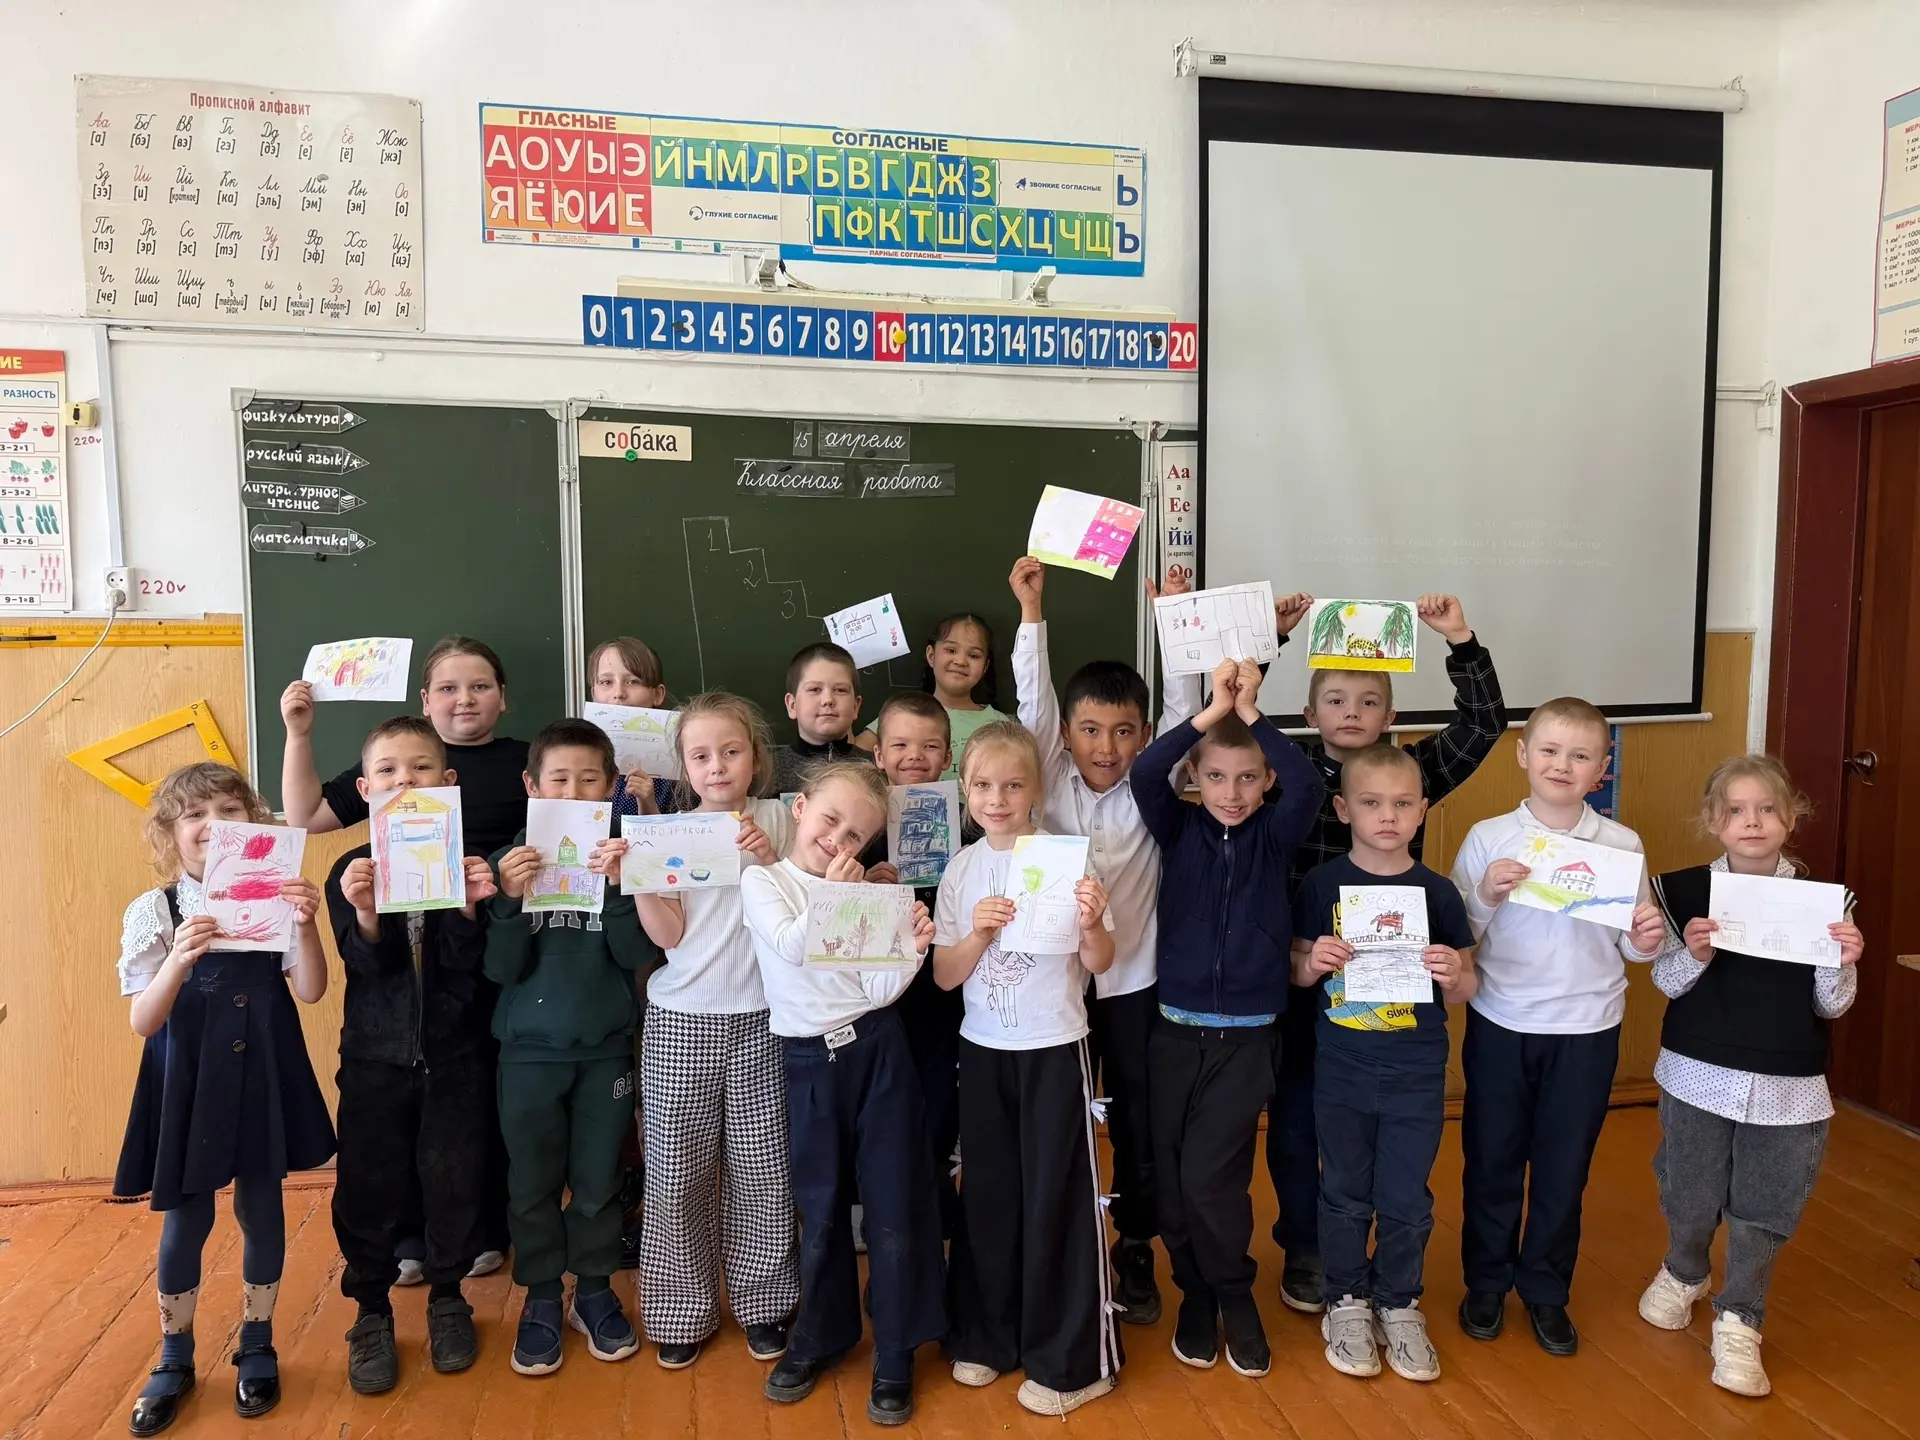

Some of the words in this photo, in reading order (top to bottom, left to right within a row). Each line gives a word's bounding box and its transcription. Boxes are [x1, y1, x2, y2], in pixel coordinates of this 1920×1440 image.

[190, 93, 254, 111] Прописной
[260, 101, 310, 116] алфавит
[89, 112, 110, 129] Аа
[133, 114, 157, 130] Бб
[176, 116, 193, 132] Вв
[221, 117, 234, 134] Гг
[261, 121, 279, 140] Дд
[301, 125, 313, 141] Ее
[341, 125, 354, 144] Ёё
[376, 129, 408, 147] Жж
[519, 111, 616, 130] ГЛАСНЫЕ
[832, 131, 948, 152] СОГЛАСНЫЕ
[95, 163, 110, 184] Зз
[134, 165, 151, 182] Ии
[176, 165, 194, 185] Йй
[220, 171, 237, 187] Кк
[258, 175, 279, 191] Лл
[348, 180, 367, 196] Нн
[395, 182, 408, 199] Оо
[1030, 181, 1060, 190] ЗВОНКИЕ
[1061, 183, 1102, 192] СОГЛАСНЫЕ
[705, 211, 732, 220] ГЛУХИЕ
[735, 212, 778, 220] СОГЛАСНЫЕ
[93, 216, 115, 235] Пп
[142, 219, 157, 239] Рр
[180, 220, 194, 237] Сс
[213, 222, 242, 240] Тт
[265, 226, 278, 247] Уу
[305, 229, 323, 250] Фф
[344, 231, 367, 249] Хх
[392, 234, 412, 252] Цц
[900, 251, 942, 259] СОГЛАСНЫЕ
[590, 304, 606, 338] 0
[621, 307, 633, 339] 1
[650, 308, 666, 341] 2
[681, 310, 695, 343] 3
[710, 312, 726, 344] 4
[740, 313, 753, 346] 5
[768, 314, 783, 347] 6
[797, 315, 812, 348] 7
[824, 317, 840, 350] 8
[853, 319, 868, 352] 9
[878, 321, 901, 354] 10
[908, 322, 930, 354] 11
[940, 323, 964, 355] 12
[970, 323, 994, 356] 13
[1001, 324, 1025, 356] 14
[1031, 326, 1055, 357] 15
[1060, 327, 1083, 358] 16
[1088, 327, 1110, 359] 17
[1115, 329, 1138, 360] 18
[1143, 330, 1167, 361] 19
[1170, 331, 1194, 362] 20
[4, 389, 56, 399] РАЗНОСТЬ
[794, 432, 809, 448] 15
[825, 431, 907, 457] апреля
[246, 449, 302, 462] русский
[307, 454, 341, 465] язык
[737, 461, 842, 486] Классная
[861, 466, 942, 498] работа
[1167, 464, 1190, 479] Аа
[268, 498, 320, 511] чтение
[1169, 498, 1191, 512] Ее
[253, 533, 348, 546] математика
[708, 528, 720, 551] 1
[1168, 527, 1192, 545] Йй
[743, 560, 760, 587] 2
[781, 590, 795, 618] 3
[210, 740, 218, 750] 10
